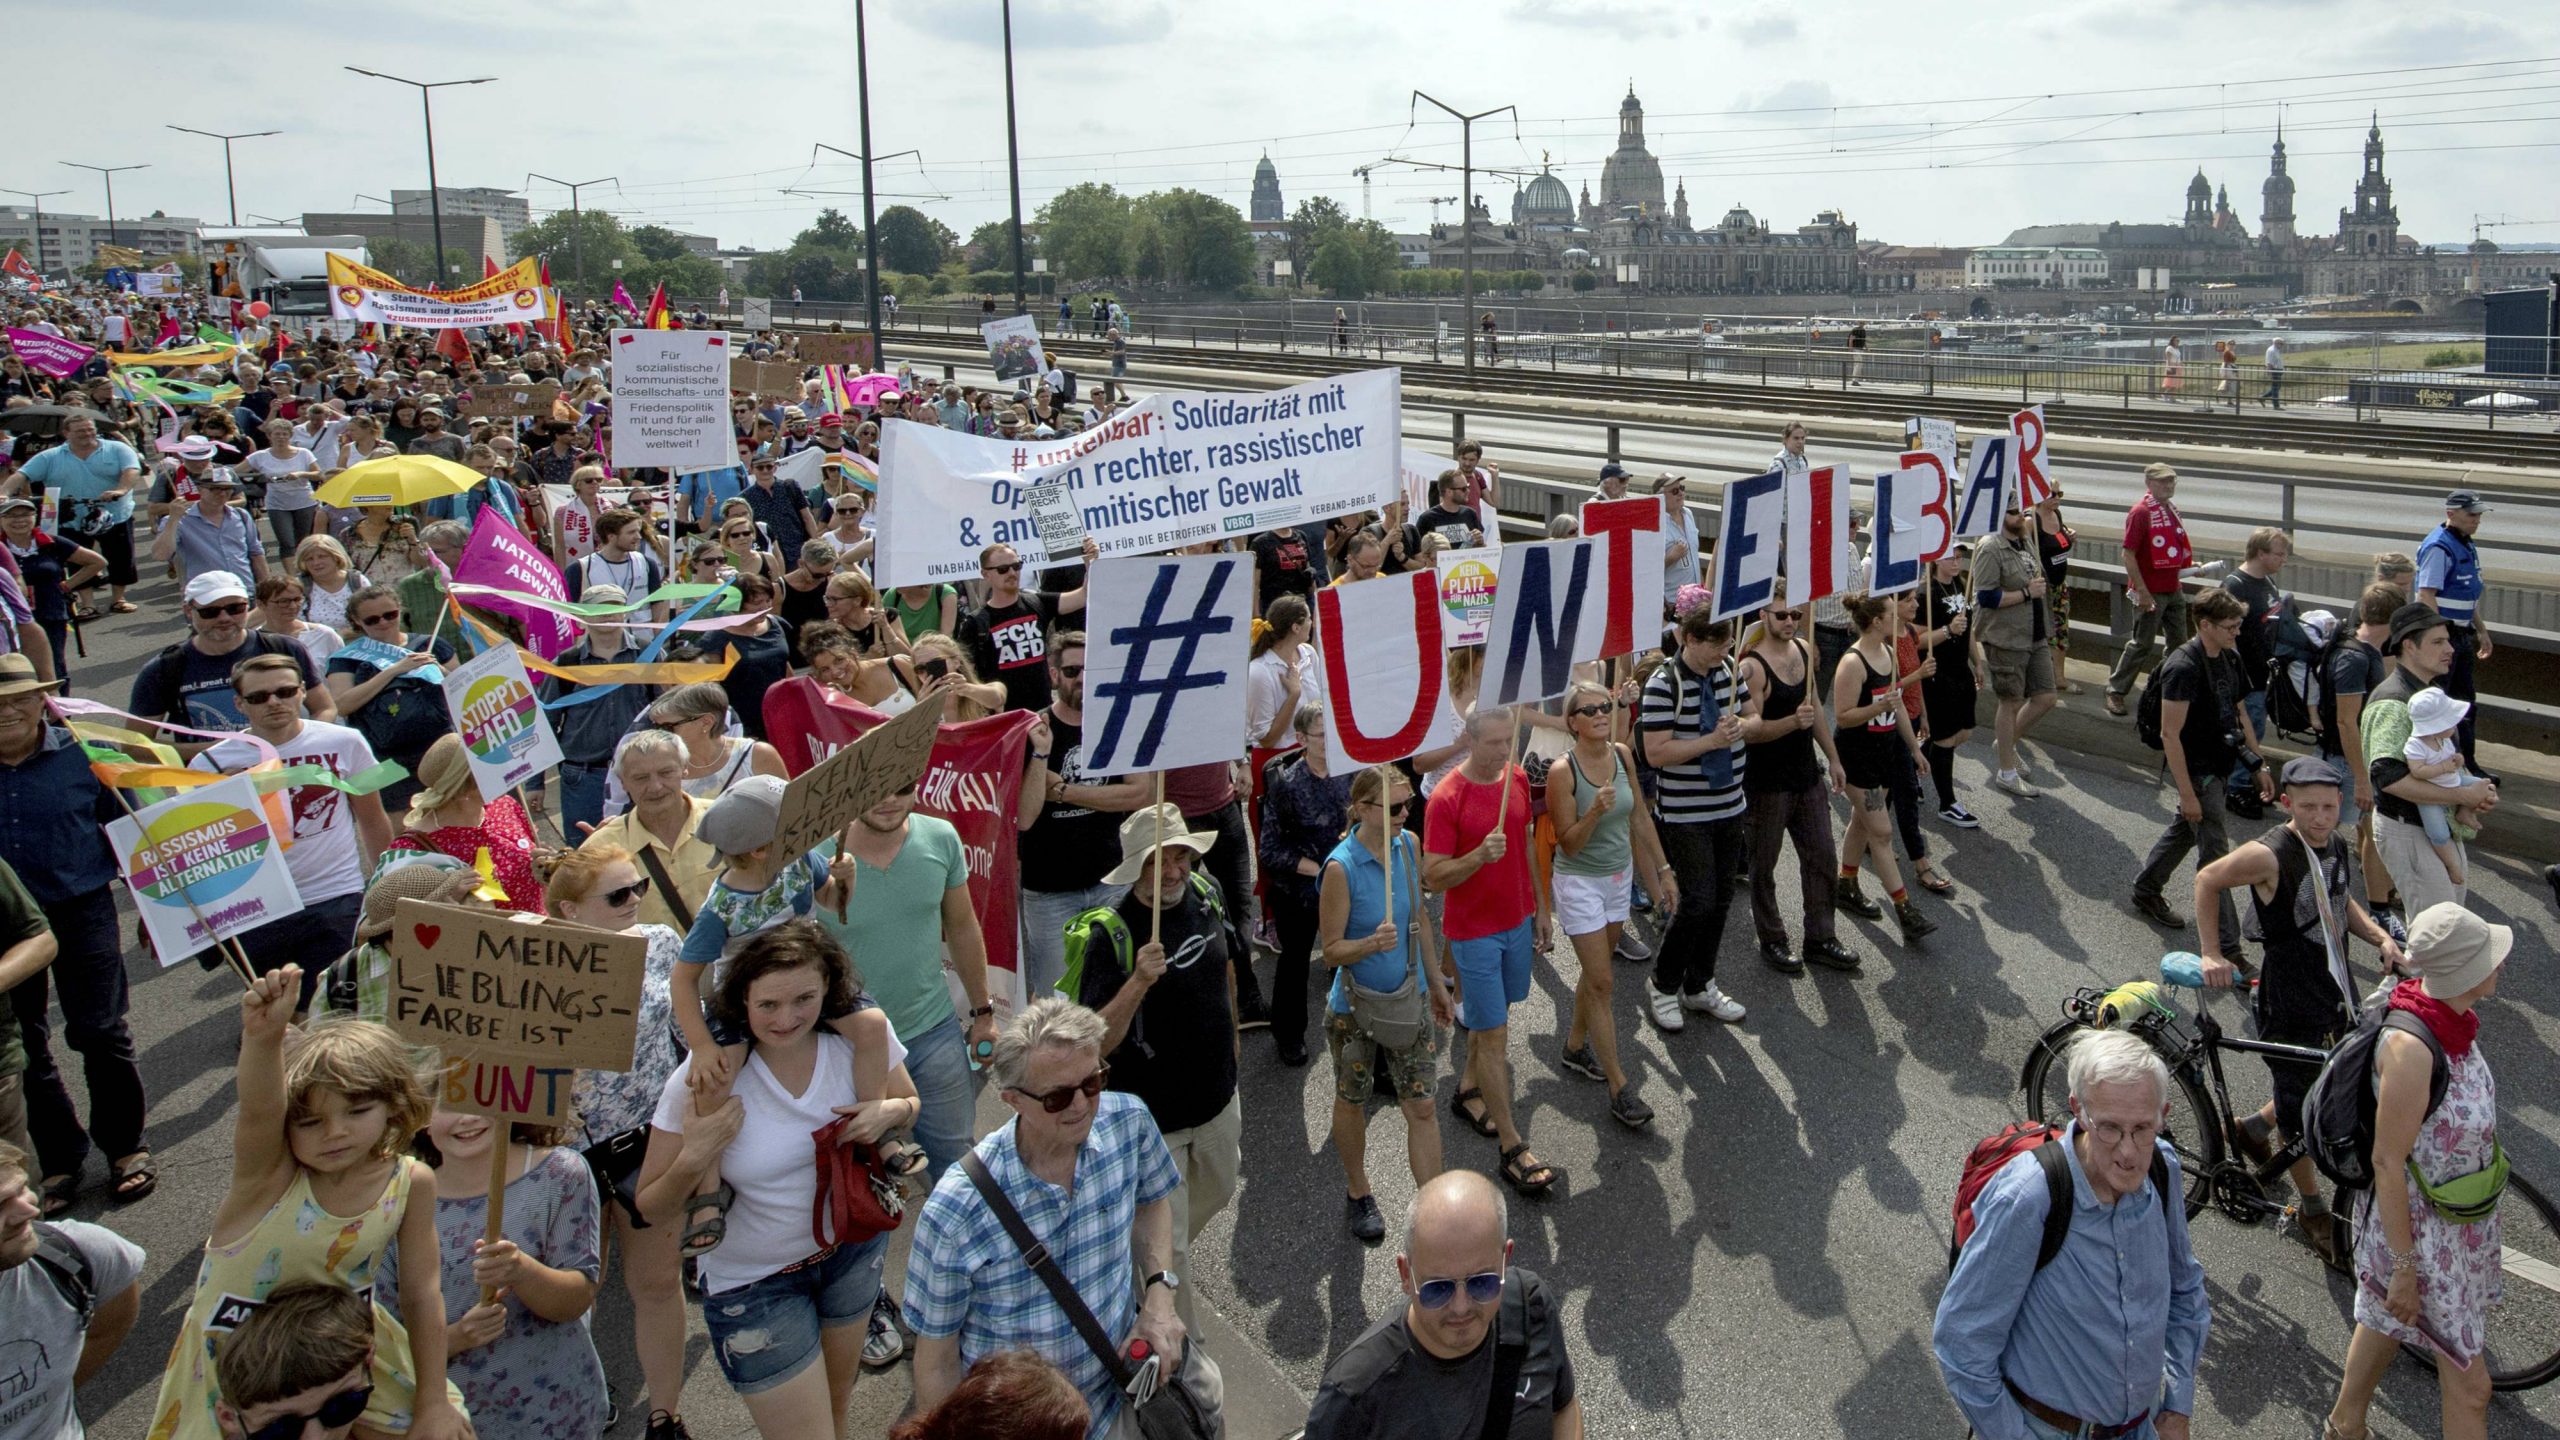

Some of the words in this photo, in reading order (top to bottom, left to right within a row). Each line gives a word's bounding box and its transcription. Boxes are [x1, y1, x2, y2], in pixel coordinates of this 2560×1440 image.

[391, 293, 417, 303] Statt
[478, 279, 519, 301] ALLE!
[371, 301, 427, 314] Rassismus
[430, 304, 450, 314] und
[453, 306, 508, 315] Konkurrenz
[386, 314, 449, 324] #zusammen
[452, 315, 494, 324] #birlikte
[660, 350, 681, 360] Für
[635, 363, 713, 373] sozialistische
[625, 375, 719, 385] kommunistische
[616, 386, 700, 397] Gesellschafts-
[703, 387, 725, 397] und
[630, 402, 714, 413] Friedenspolitik
[1172, 394, 1302, 432] Solidarität
[1308, 383, 1347, 416] mit
[630, 416, 648, 425] mit
[651, 416, 674, 425] und
[677, 415, 693, 424] für
[695, 415, 716, 424] alle
[641, 427, 701, 436] Menschen
[645, 439, 692, 449] weltweit
[1093, 446, 1200, 487] rechter,
[1206, 422, 1365, 469] rassistischer
[1027, 487, 1063, 500] BLEIBE-
[1031, 495, 1061, 508] RECHT
[959, 516, 982, 547] &
[1217, 467, 1303, 508] Gewalt
[1034, 508, 1042, 517] &
[1310, 493, 1377, 516] VERBAND-BRG.DE
[1037, 511, 1073, 525] BEWEG-
[1041, 520, 1070, 533] UNGS-
[1225, 514, 1252, 530] VBRG
[1043, 526, 1083, 542] FREIHEIT
[1115, 537, 1135, 551] FÜR
[1138, 533, 1155, 545] DIE
[1157, 522, 1217, 544] BETROFFENEN
[1460, 563, 1480, 577] KEIN
[1449, 576, 1485, 594] PLATZ
[1450, 594, 1462, 604] FÜR
[1463, 592, 1490, 607] NAZIS
[990, 619, 1043, 649] FCK
[998, 637, 1046, 665] AFD
[461, 679, 521, 734] STOPPT
[473, 725, 484, 740] DIE
[483, 707, 524, 753] AFD
[802, 735, 881, 810] KEIN
[922, 760, 958, 812] FÜR
[782, 761, 898, 843] KLEINES
[139, 818, 238, 867] RASSISMUS
[781, 812, 846, 861] KIND
[153, 856, 180, 881] IST
[184, 839, 231, 873] KEINE
[158, 843, 263, 898] ALTERNATIVE
[475, 929, 610, 974] MEINE
[396, 957, 632, 1024] LIEBLINGS-
[396, 997, 503, 1041] FARBE
[521, 1022, 573, 1046] IST
[445, 1055, 574, 1117] BUNT
